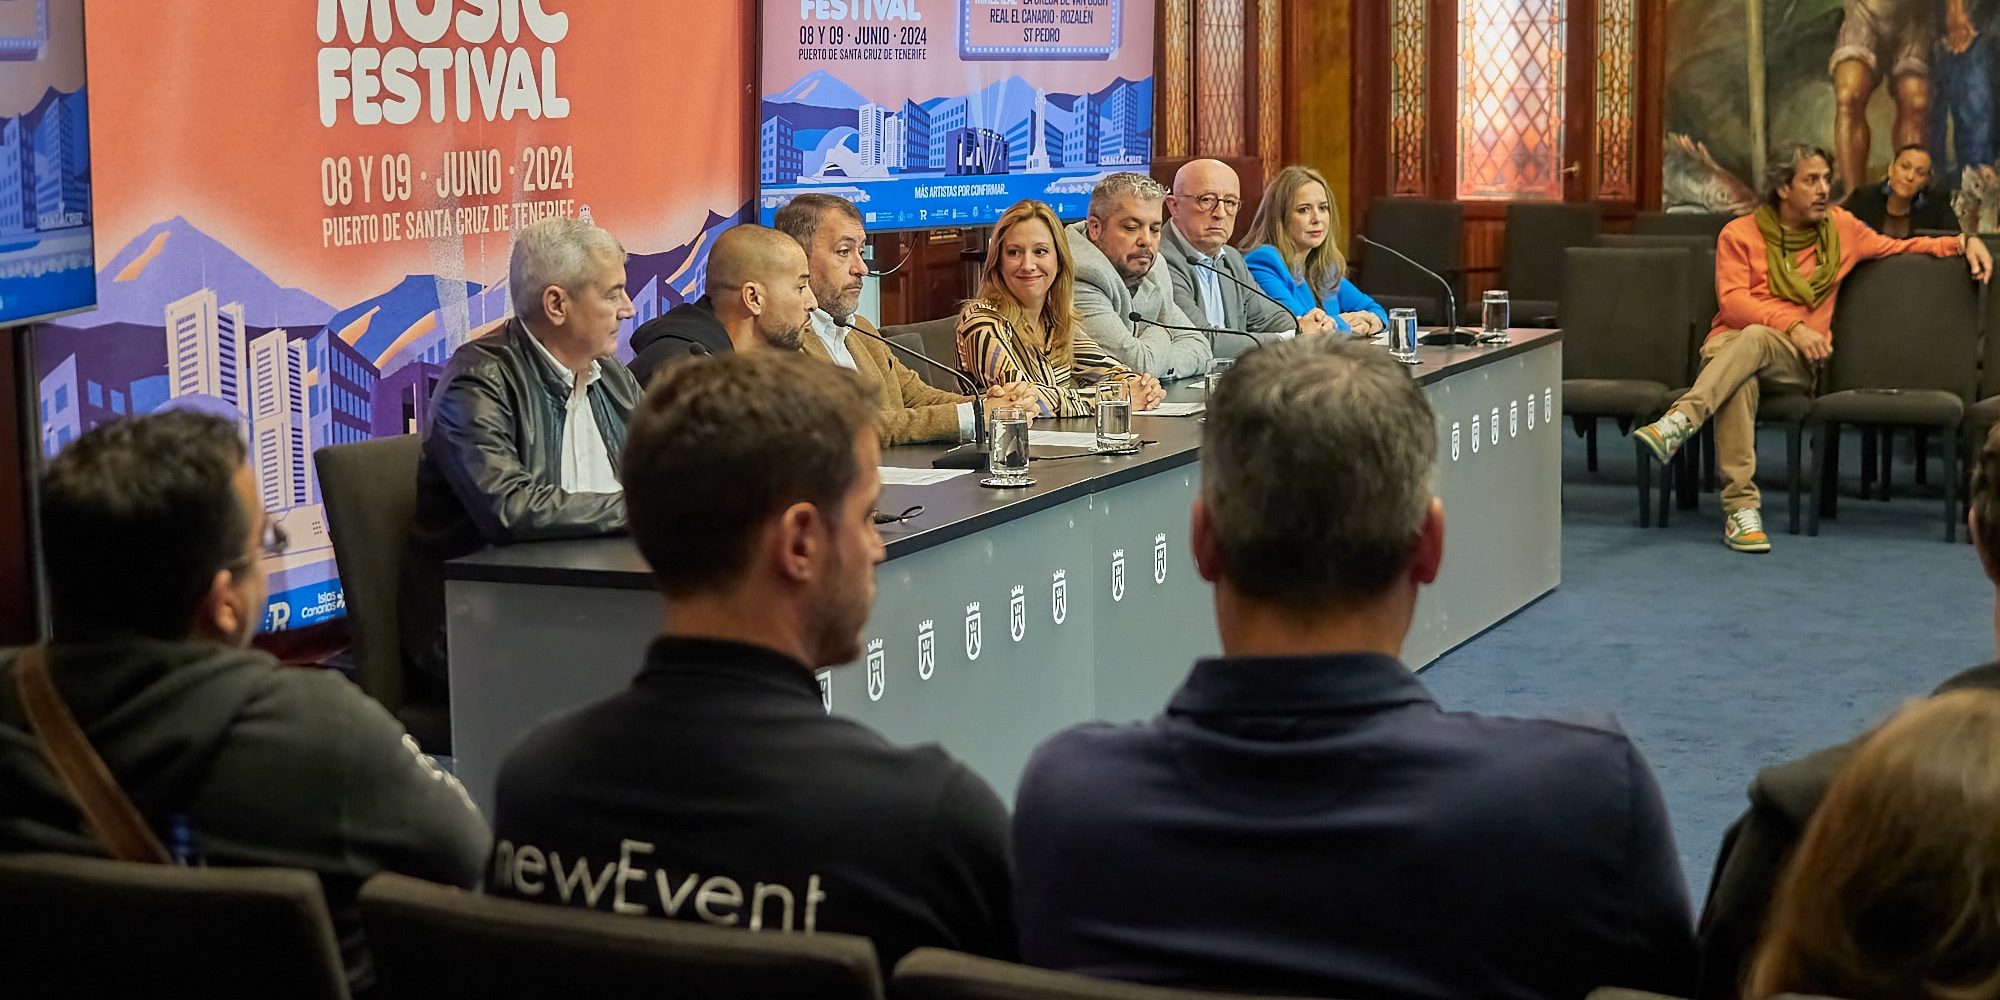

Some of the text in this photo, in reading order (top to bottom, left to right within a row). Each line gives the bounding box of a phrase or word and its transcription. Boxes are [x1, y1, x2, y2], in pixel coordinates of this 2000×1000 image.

[990, 7, 1093, 24] REAL EL CANARIO ROZALÉN
[799, 25, 927, 45] 08 Y 09 JUNIO 2024
[1023, 28, 1060, 42] ST PEDRO
[798, 48, 927, 60] PUERTO DE SANTA CRUZ DE TENERIFE
[317, 46, 570, 128] FESTIVAL
[321, 145, 574, 207] 08 Y 09 JUNIO 2024
[914, 184, 929, 199] MÁS
[929, 185, 958, 199] ARTISTAS
[959, 184, 971, 197] POR
[322, 214, 379, 248] PUERTO
[382, 212, 401, 242] DE
[405, 208, 453, 240] SANTA
[456, 205, 490, 236] CRUZ
[492, 203, 510, 232] DE
[317, 591, 337, 605] Islas
[301, 601, 337, 619] Canarias
[496, 838, 826, 935] newEvent
